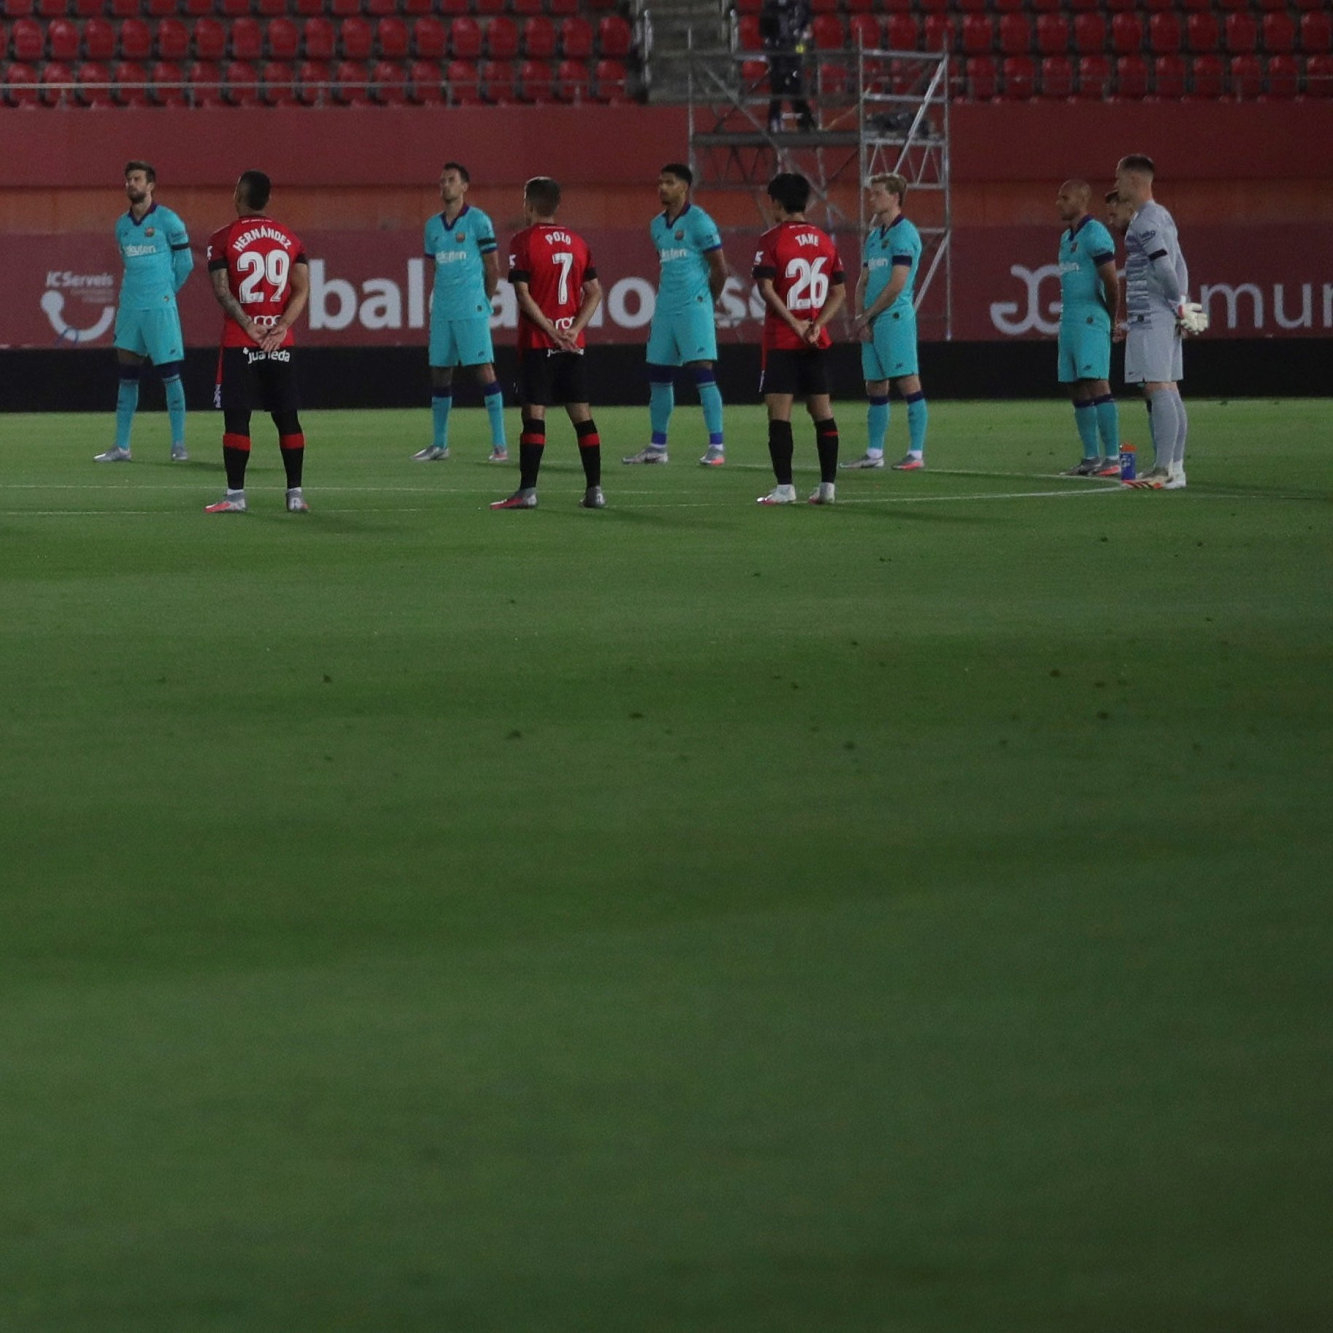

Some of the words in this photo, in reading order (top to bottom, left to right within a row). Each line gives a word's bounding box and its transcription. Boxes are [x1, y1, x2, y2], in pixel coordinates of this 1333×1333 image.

[233, 226, 292, 252] HERNÁNDEZ
[545, 232, 572, 245] POZO
[237, 249, 290, 304] 29
[552, 252, 573, 305] 7
[785, 257, 829, 310] 26
